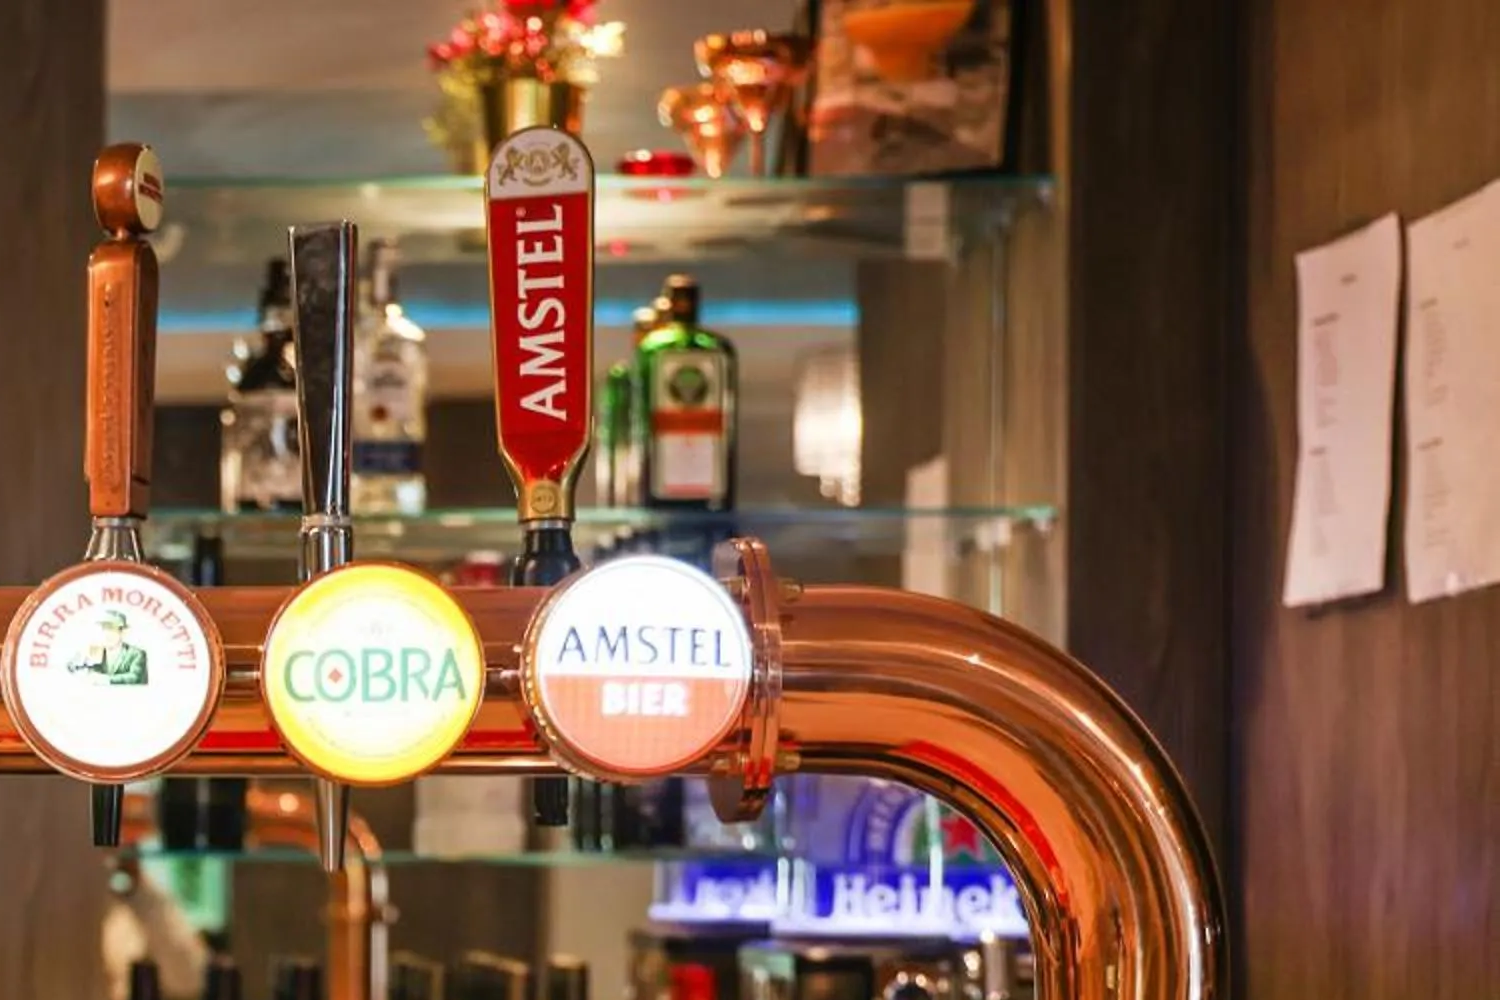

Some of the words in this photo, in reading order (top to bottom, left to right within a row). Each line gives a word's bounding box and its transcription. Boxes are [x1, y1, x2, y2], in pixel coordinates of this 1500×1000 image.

[516, 203, 567, 422] AMSTEL
[29, 592, 94, 669] BIRRA
[101, 586, 197, 671] MORETTI
[556, 624, 732, 668] AMSTEL
[283, 647, 467, 703] COBRA
[602, 681, 688, 717] BIER
